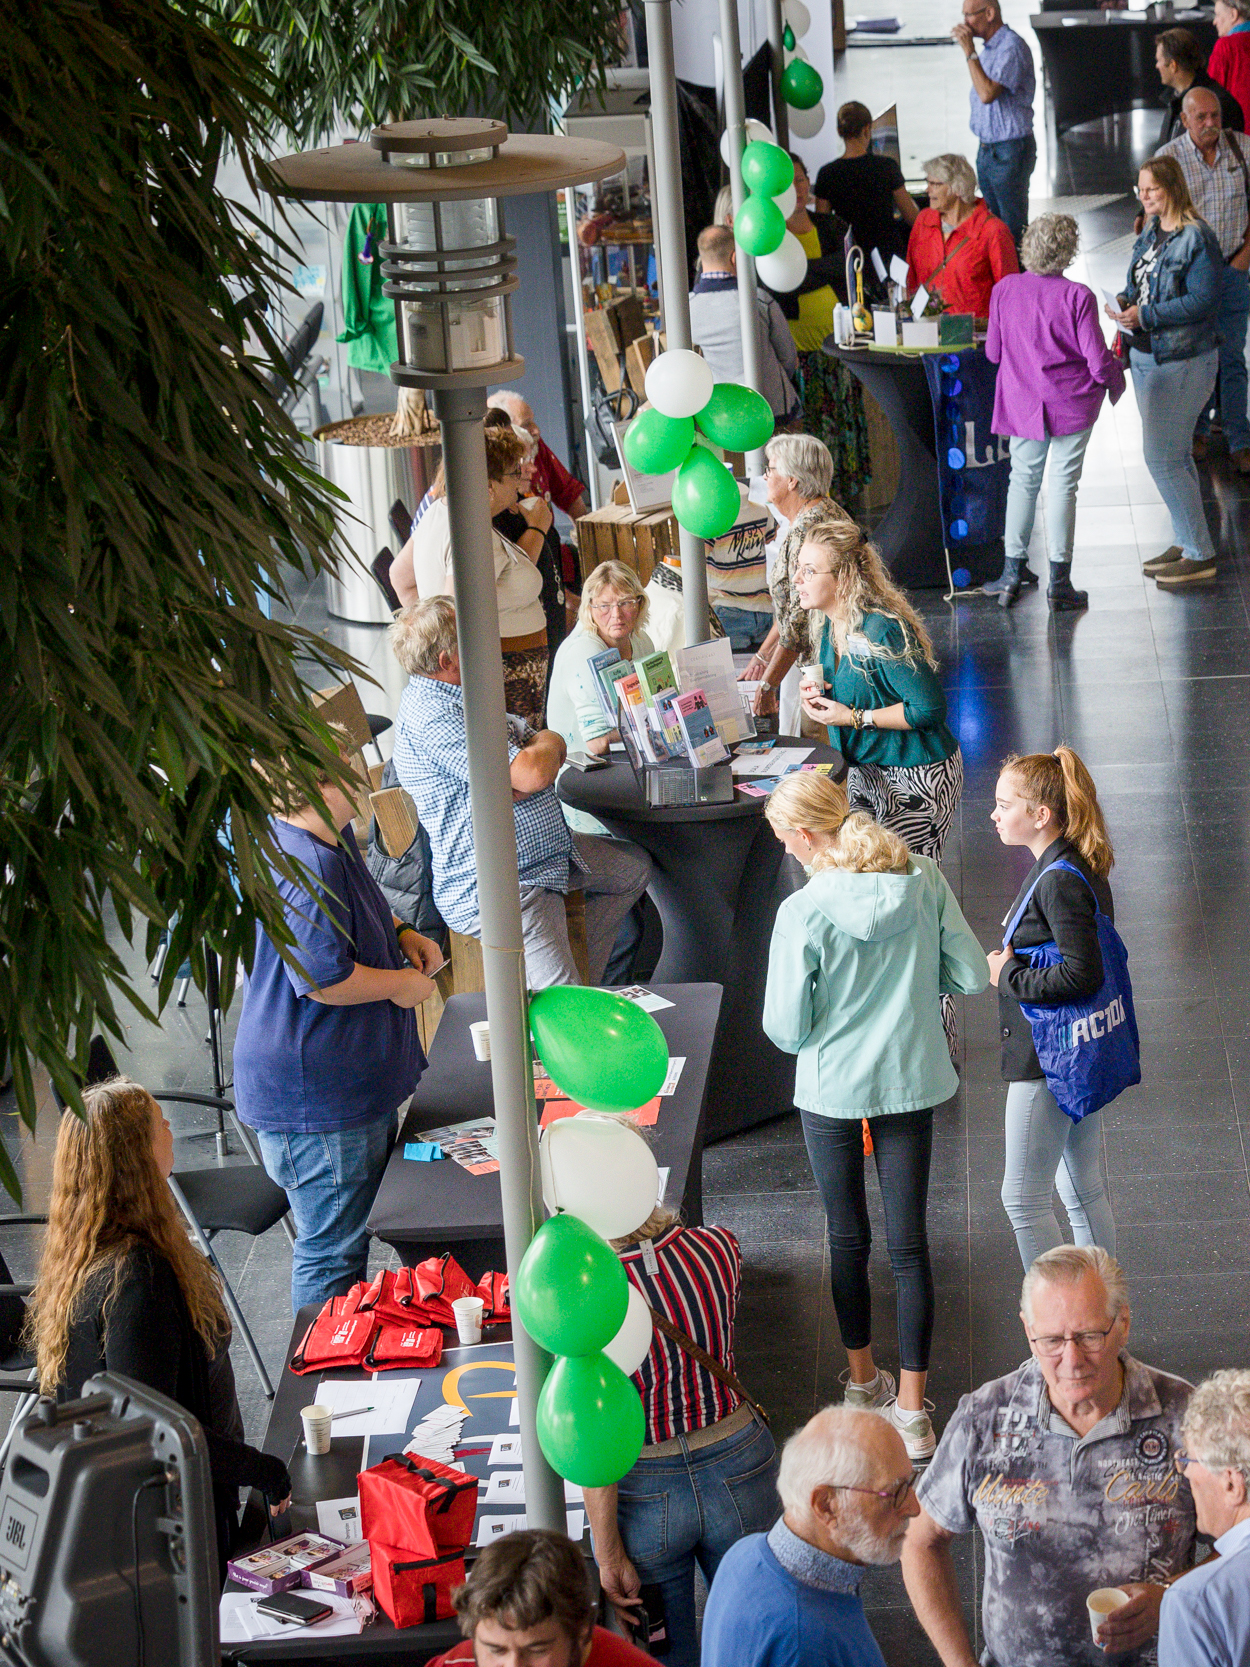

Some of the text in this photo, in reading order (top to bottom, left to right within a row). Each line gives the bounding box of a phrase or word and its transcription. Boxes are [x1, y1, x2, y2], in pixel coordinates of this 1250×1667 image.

[972, 1473, 1049, 1505] Monte
[1105, 1468, 1179, 1502] Carlo
[5, 1515, 26, 1550] JBL
